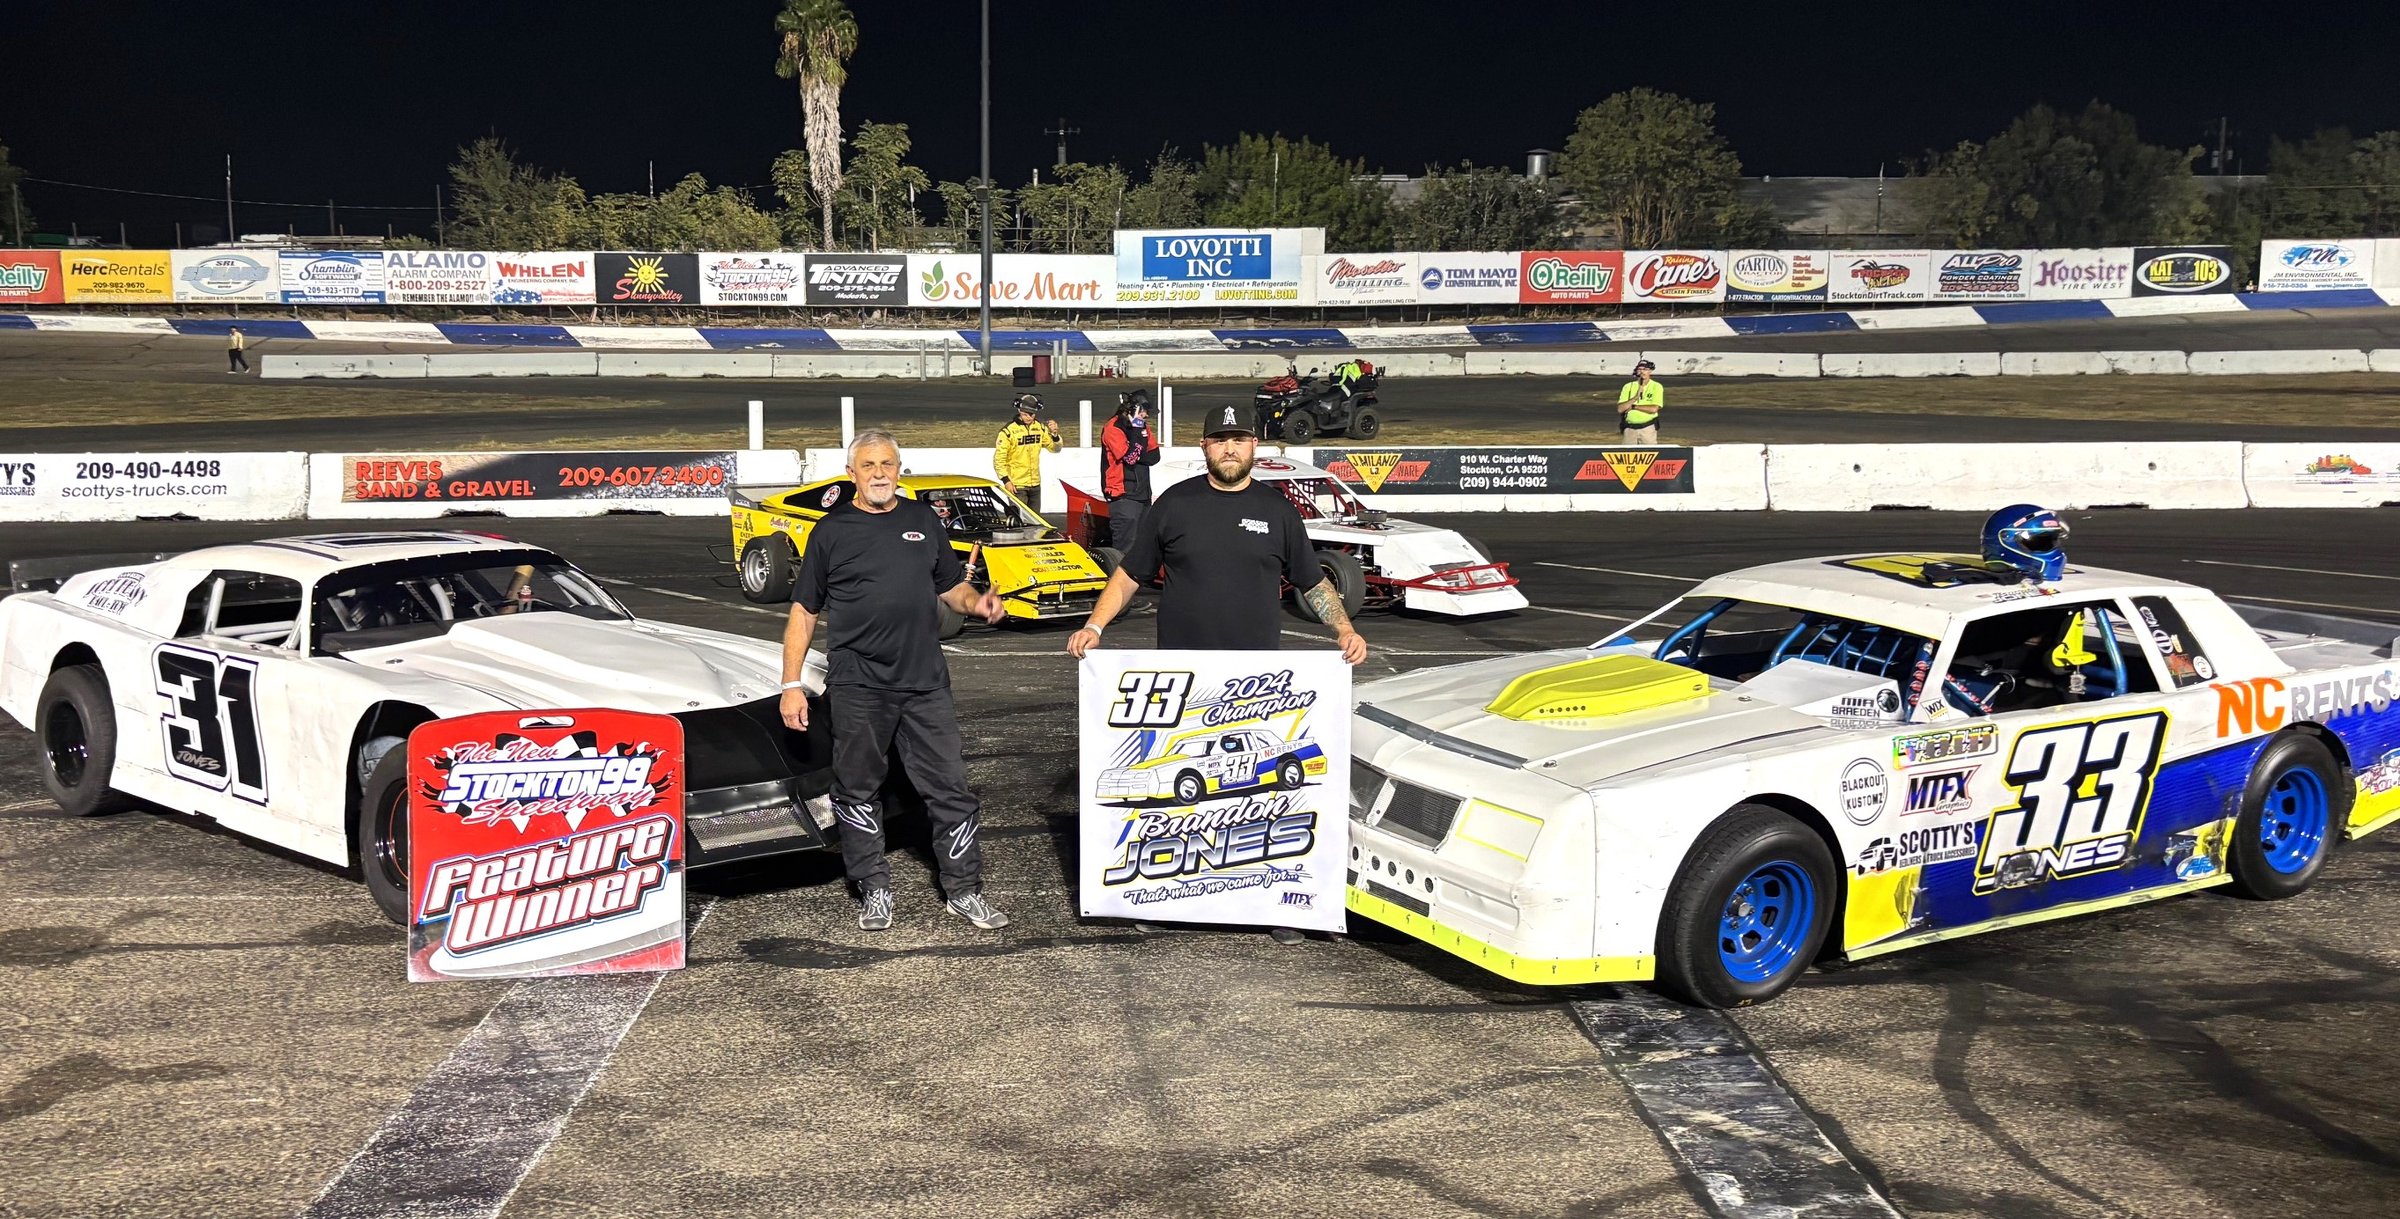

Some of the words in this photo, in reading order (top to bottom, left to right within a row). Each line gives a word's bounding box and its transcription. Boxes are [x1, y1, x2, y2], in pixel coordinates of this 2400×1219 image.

[1155, 238, 1262, 258] LOVOTTI
[71, 263, 165, 276] HercRentals
[387, 253, 486, 268] ALAMO
[496, 261, 585, 278] WHELEN
[1186, 258, 1232, 277] INC
[1664, 256, 1695, 265] Raising
[1736, 257, 1784, 272] GARTON
[299, 259, 356, 281] Shamblin
[392, 270, 428, 278] ALARM
[430, 270, 482, 279] COMPANY
[809, 268, 901, 284] TINTING
[1445, 268, 1475, 278] TOM
[1479, 268, 1517, 279] MAYO
[1532, 262, 1607, 289] O'Reilly
[1633, 254, 1720, 297] Cane's
[2033, 258, 2128, 286] Hoosier
[2150, 260, 2174, 276] KAT
[2194, 259, 2218, 281] 103
[307, 286, 360, 294] 209-923-1770
[388, 280, 487, 290] 1-800-209-2527
[613, 278, 683, 302] Sunnyvalley
[1024, 272, 1103, 301] Mart
[1117, 282, 1144, 290] Heating
[1171, 282, 1205, 290] Plumbing
[1251, 280, 1298, 288] Refrigeration
[1336, 279, 1404, 288] DRILLING
[1445, 279, 1502, 288] CONSTRUCTION,
[1505, 279, 1517, 287] INC
[402, 293, 435, 302] REMEMBER
[437, 293, 448, 302] THE
[718, 292, 788, 301] STOCKTON99.COM
[1116, 290, 1201, 302] 209.931.2100
[1215, 289, 1297, 301] LOVOTTIINC.COM
[1831, 291, 1924, 300] StocktonDirtTrack.com
[1352, 454, 1400, 467] J.MILANO
[1460, 455, 1477, 464] 910
[1478, 455, 1490, 464] W.
[1492, 455, 1527, 464] Charter
[1528, 455, 1548, 466] Way
[1608, 453, 1656, 465] J.MILANO
[0, 462, 36, 486] Y'S
[76, 460, 221, 479] 209-490-4498
[355, 460, 444, 482] REEVES
[558, 466, 724, 487] 209-607-2400
[1460, 465, 1504, 476] Stockton,
[1506, 465, 1520, 475] CA
[1521, 465, 1548, 475] 95201
[1585, 463, 1608, 476] HARD
[1653, 463, 1676, 476] WARE
[1626, 465, 1636, 474] CO.
[61, 482, 228, 500] scottys-trucks.com
[355, 481, 418, 499] SAND
[424, 482, 442, 498] &
[449, 480, 534, 498] GRAVEL
[1459, 476, 1490, 489] (209)
[1492, 476, 1548, 488] 944-0902
[1220, 669, 1293, 702] 2024
[1107, 670, 1194, 728] 33
[1925, 699, 1945, 715] WIX
[2209, 677, 2286, 738] NC
[2290, 673, 2392, 723] RENTS
[1202, 690, 1316, 728] Champion
[1831, 706, 1880, 717] BRAEDEN
[154, 646, 266, 803] 31
[176, 749, 221, 771] JONES
[454, 742, 497, 761] The
[502, 741, 559, 760] New
[1264, 749, 1276, 758] NC
[1223, 753, 1258, 782] 33
[1842, 774, 1885, 792] BLACKOUT
[1905, 769, 1974, 812] MTFX
[1846, 792, 1883, 810] KUSTOMZ
[1977, 711, 2168, 878] 33
[460, 789, 656, 826] Speedway
[1138, 795, 1290, 840] Brandon
[1899, 822, 1973, 857] SCOTTY'S
[1103, 811, 1318, 887] JONES
[423, 819, 670, 914] Feature
[1170, 883, 1205, 899] what
[1206, 882, 1226, 894] we
[1226, 877, 1262, 892] came
[446, 863, 663, 951] Winner
[1278, 891, 1316, 906] MTFX
